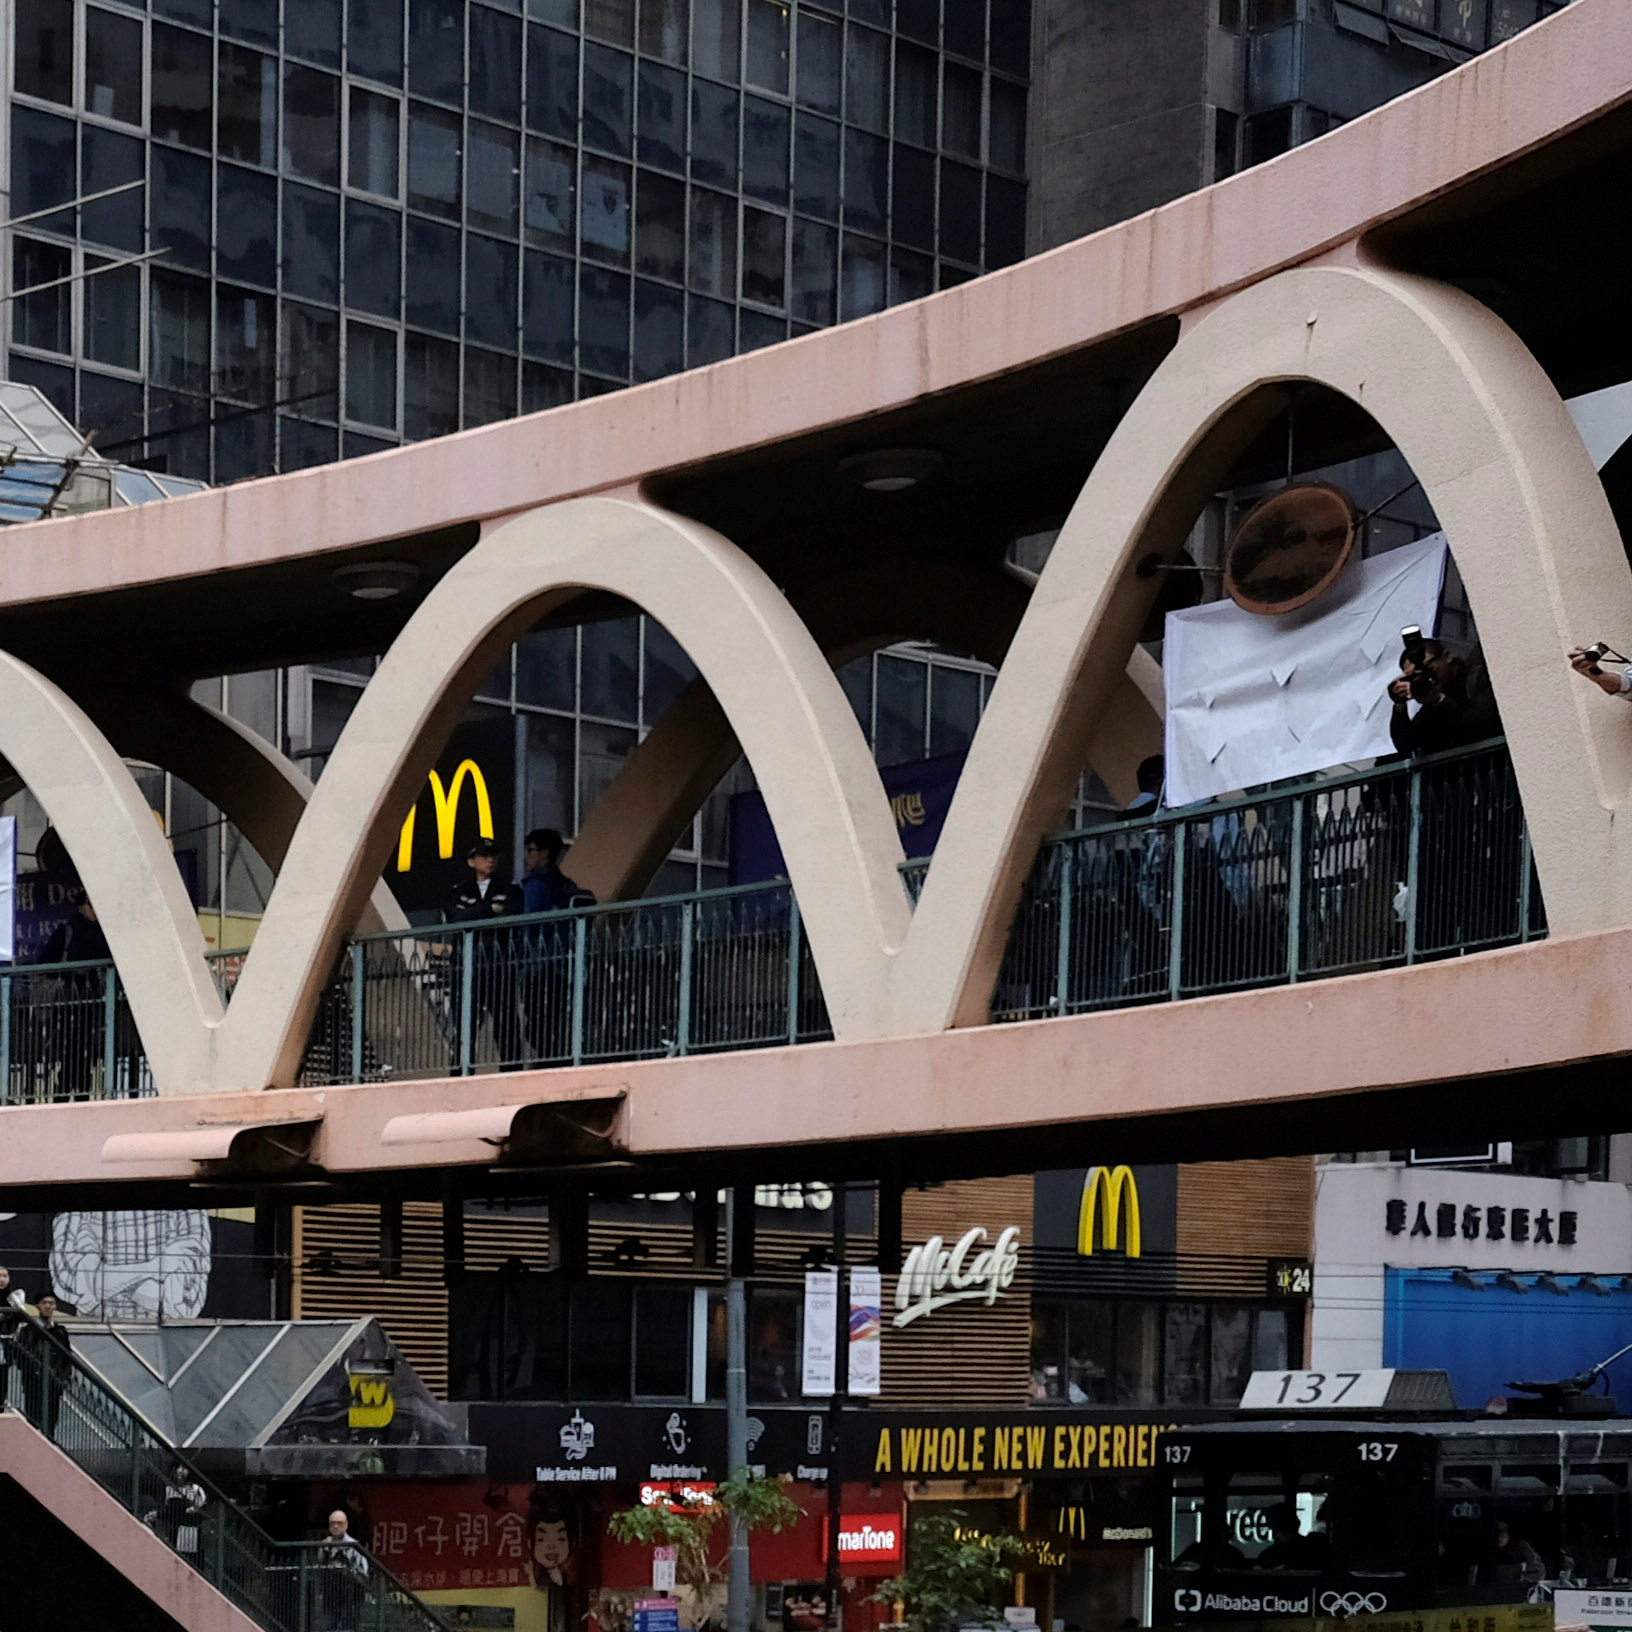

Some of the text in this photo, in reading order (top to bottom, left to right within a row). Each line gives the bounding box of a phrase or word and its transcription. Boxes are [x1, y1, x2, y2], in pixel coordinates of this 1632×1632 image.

[895, 1226, 1021, 1312] McCafé
[1277, 1372, 1361, 1404] 137
[873, 1423, 1180, 1473] A WHOLE NEW EXPERIEN
[1164, 1445, 1192, 1463] 137
[1357, 1442, 1399, 1462] 137
[836, 1525, 895, 1551] marTone
[1204, 1593, 1309, 1613] Alibaba Cloud
